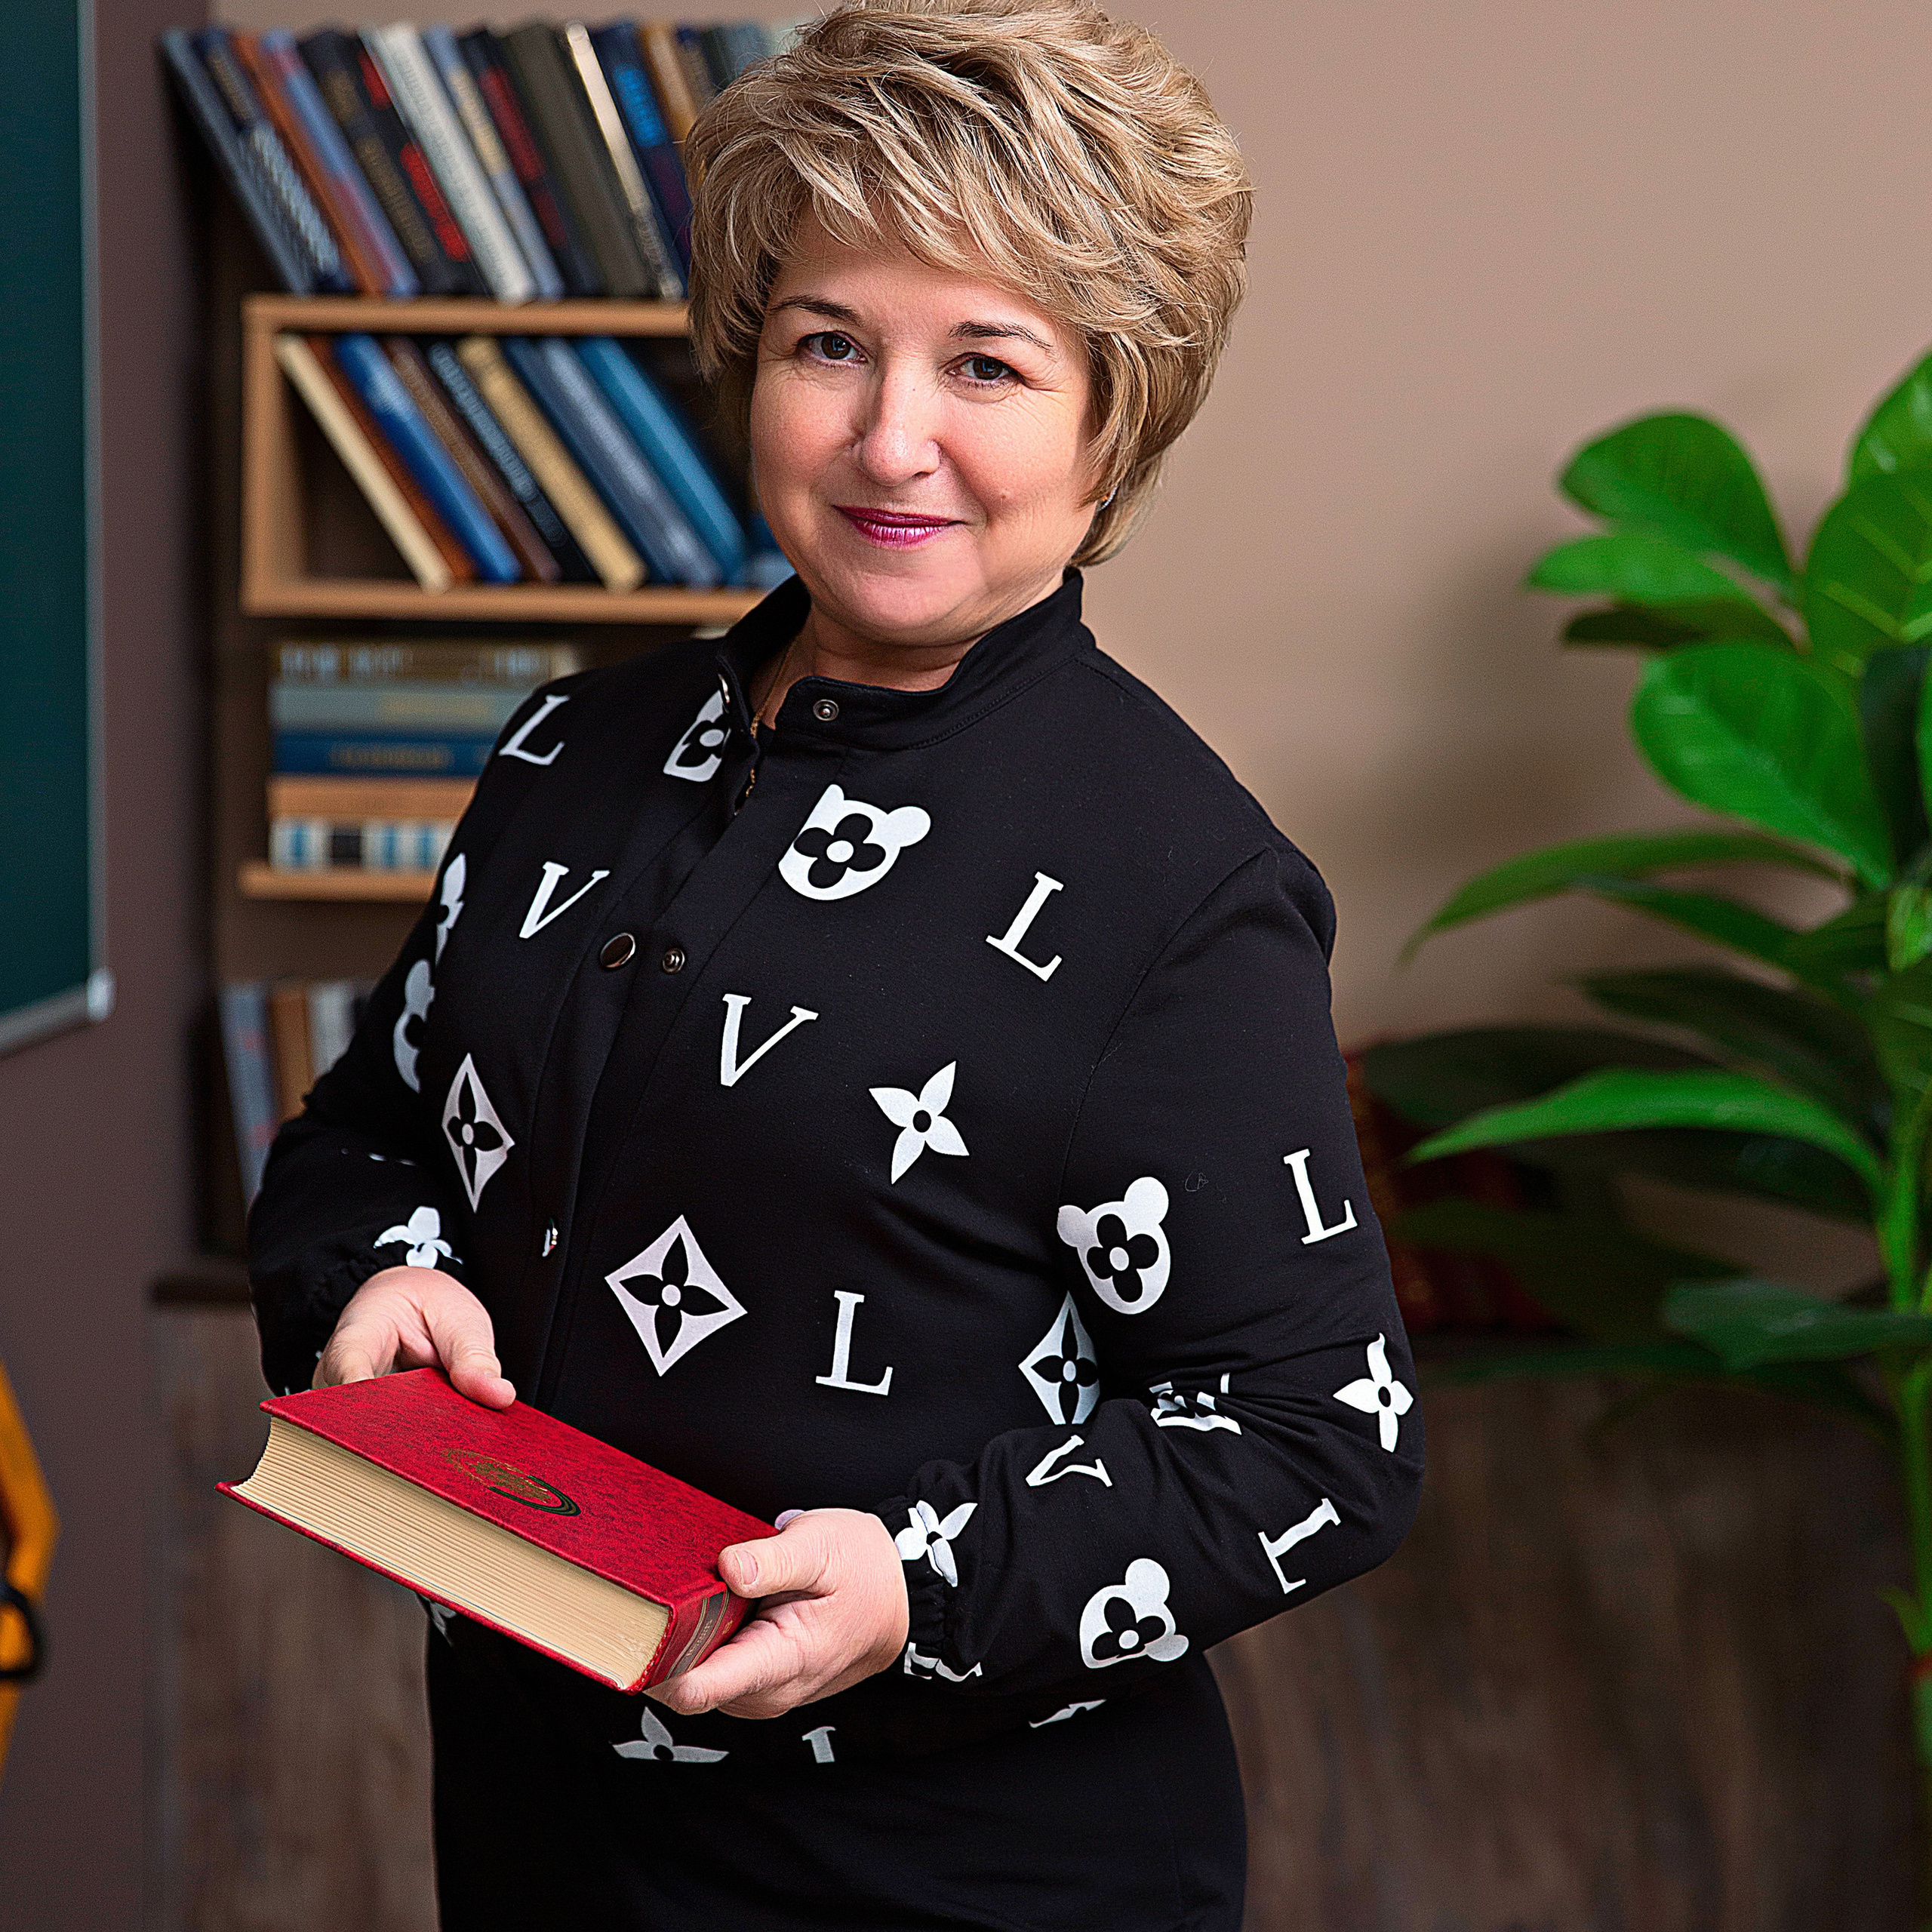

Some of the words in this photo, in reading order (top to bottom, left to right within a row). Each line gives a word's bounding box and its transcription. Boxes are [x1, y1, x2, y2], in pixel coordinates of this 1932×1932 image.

[499, 694, 569, 765] L
[518, 861, 611, 939] V
[986, 872, 1064, 982] L
[720, 993, 819, 1088] V
[1283, 1148, 1358, 1245] L
[815, 1290, 894, 1396] L
[1025, 1434, 1113, 1487] V
